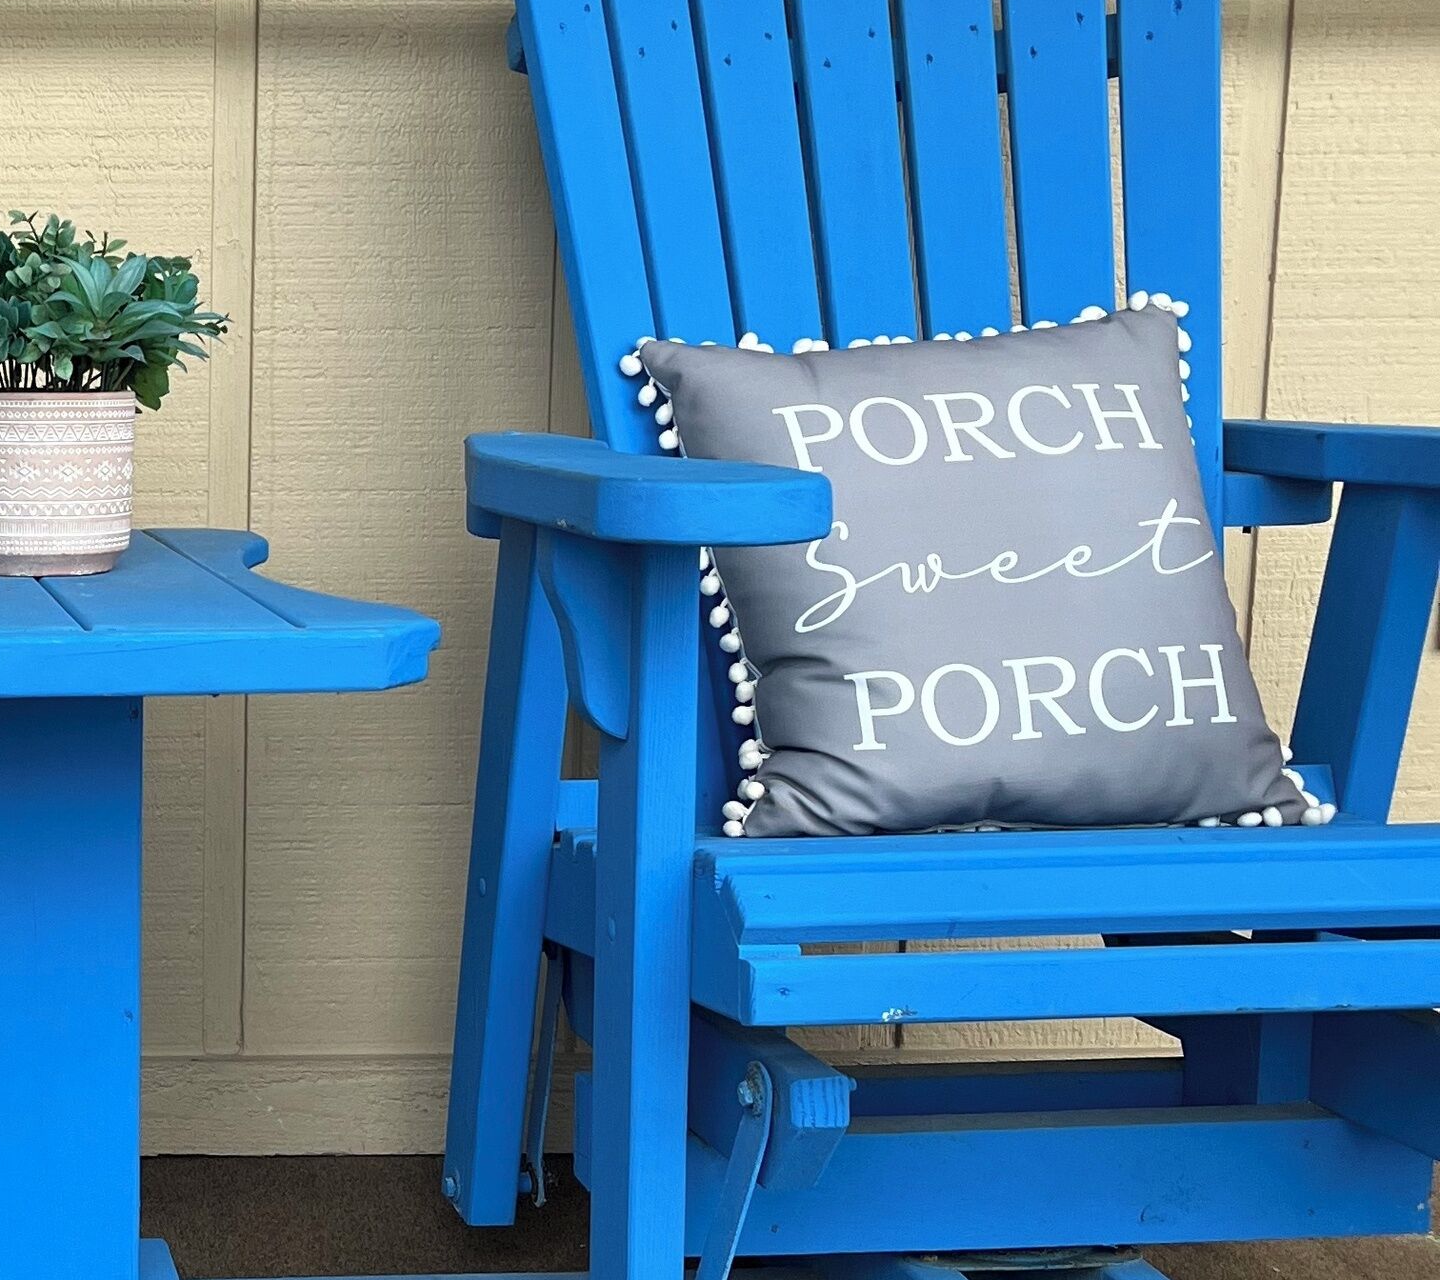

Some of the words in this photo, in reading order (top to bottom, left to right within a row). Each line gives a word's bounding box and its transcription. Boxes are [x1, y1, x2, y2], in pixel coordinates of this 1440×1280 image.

[772, 384, 1163, 473] PORCH
[795, 498, 1214, 634] Sweet
[843, 644, 1238, 752] PORCH
